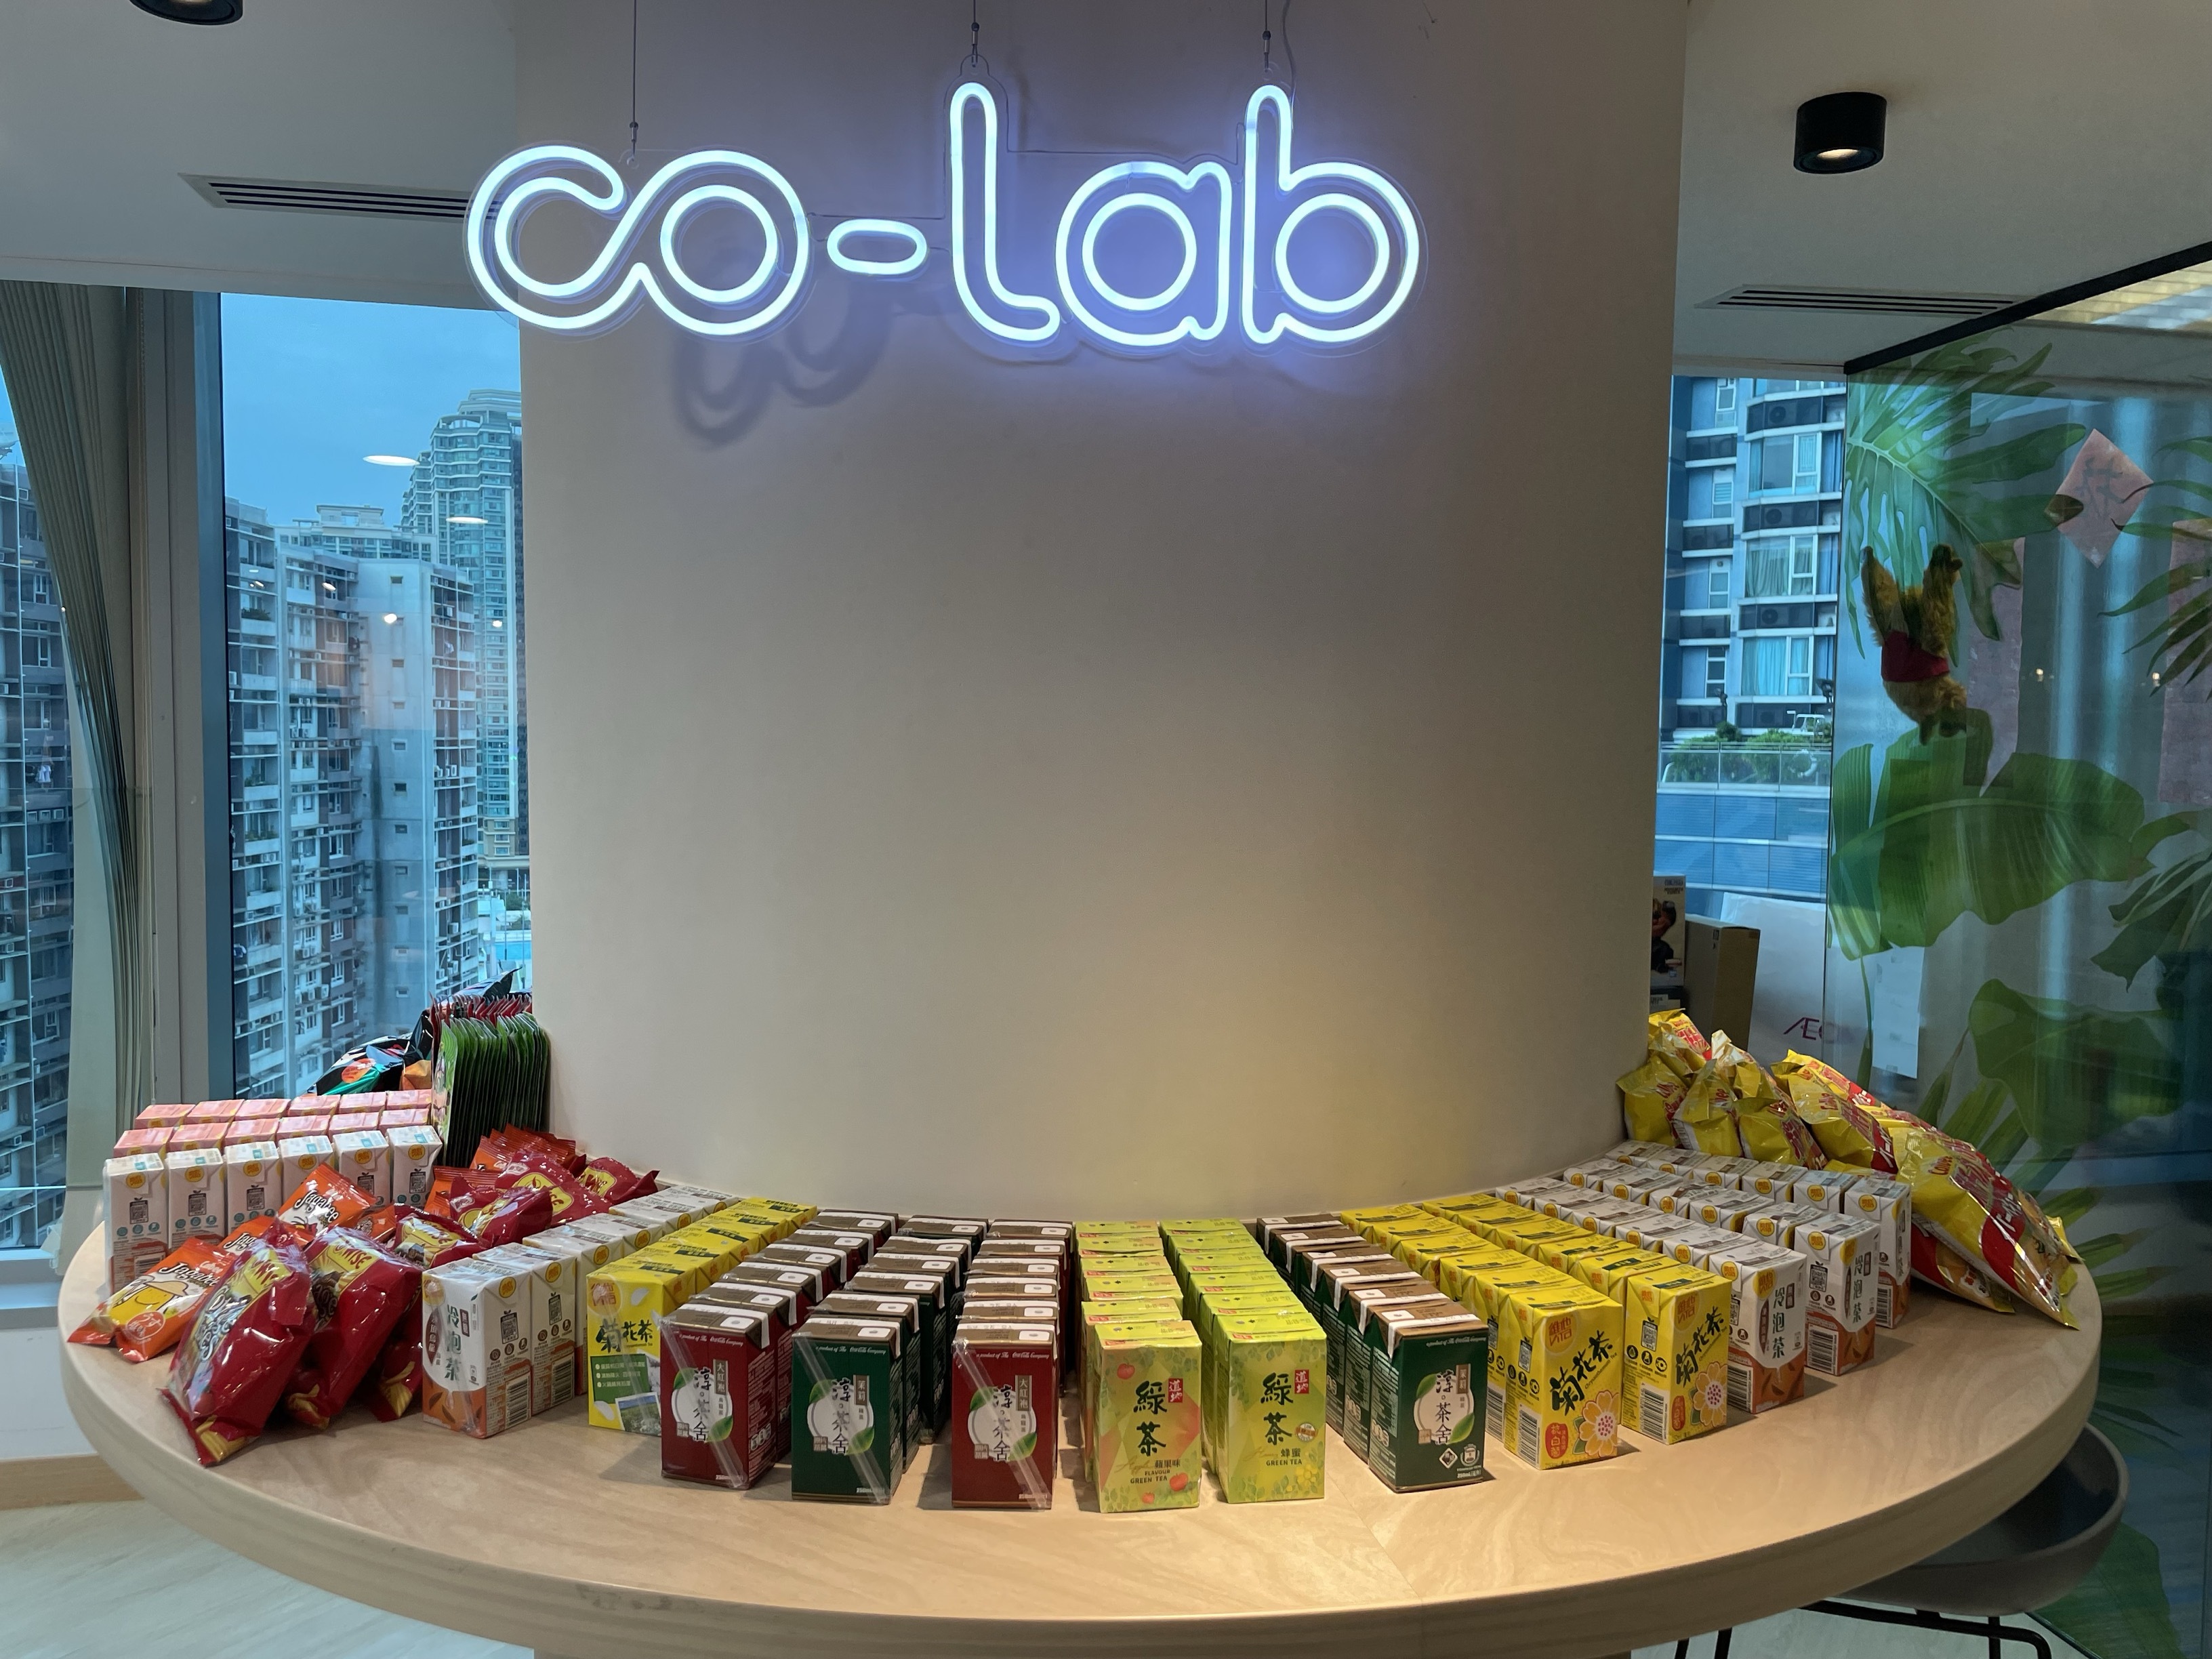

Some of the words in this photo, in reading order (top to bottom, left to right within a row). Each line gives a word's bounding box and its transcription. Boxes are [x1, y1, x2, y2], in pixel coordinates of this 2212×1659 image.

[468, 81, 1419, 346] co-lab
[294, 1189, 340, 1223] Jagabee
[596, 1318, 653, 1353] 菊花茶
[1676, 1306, 1724, 1389] 菊花茶
[1772, 1287, 1785, 1359] 冷泡茶
[717, 1362, 726, 1393] 大紅袍
[1019, 1378, 1029, 1408] 大紅袍
[1260, 1372, 1294, 1446] 綠茶
[1549, 1330, 1614, 1416] 菊花茶
[1133, 1380, 1168, 1457] 綠茶
[1280, 1448, 1301, 1458] 蜂蜜
